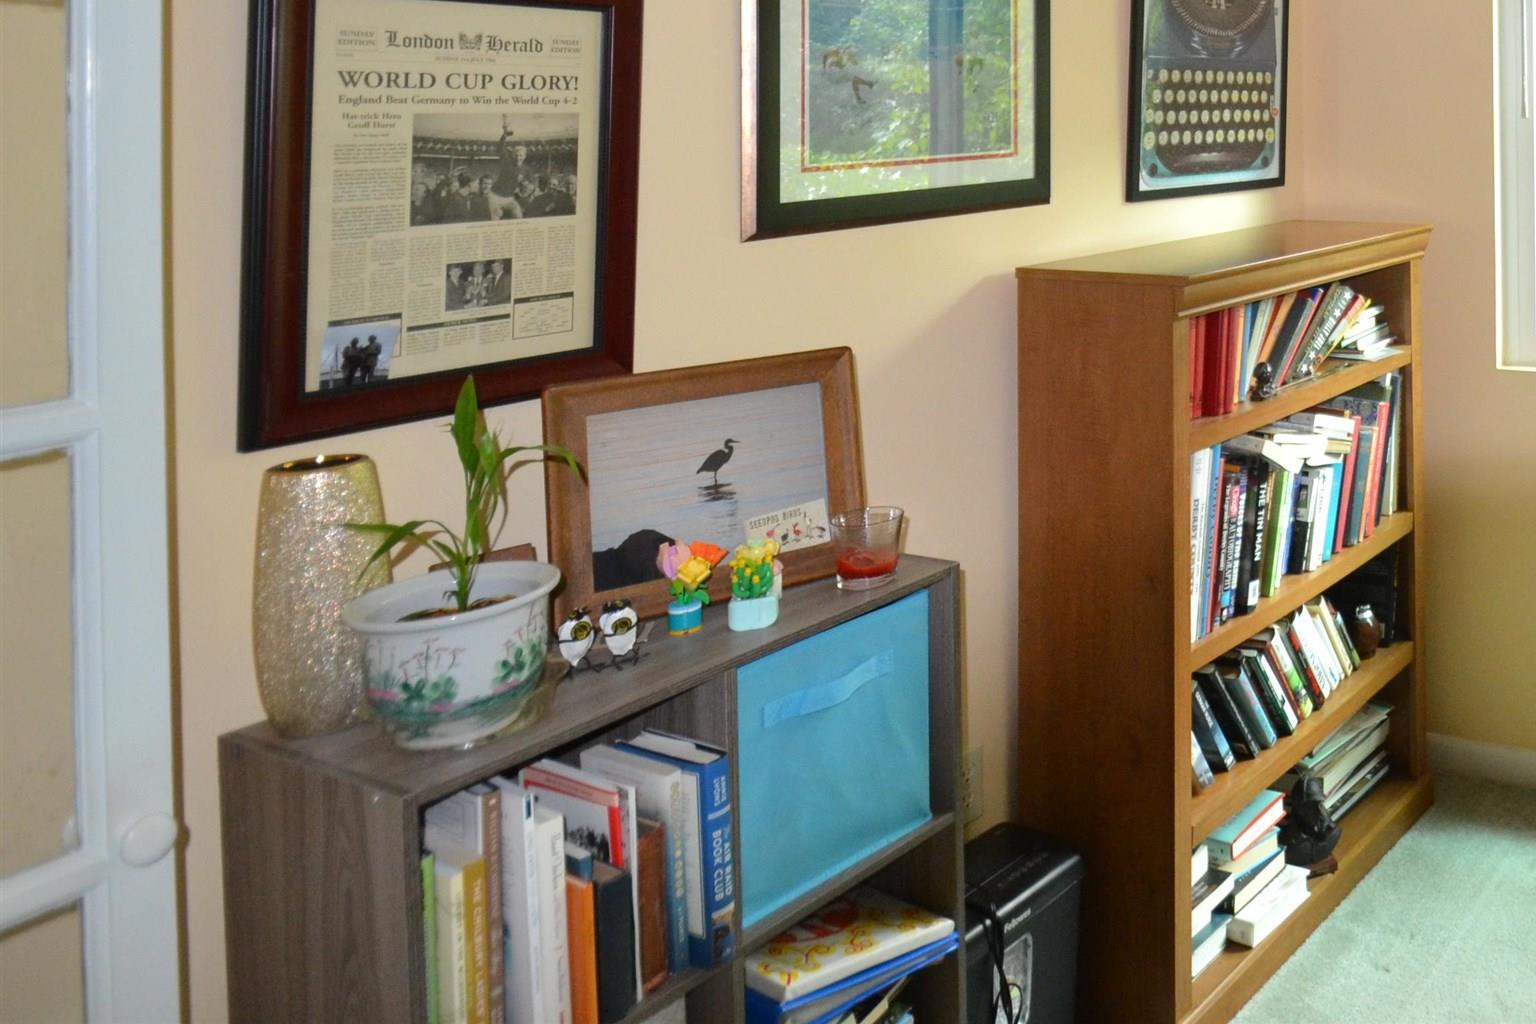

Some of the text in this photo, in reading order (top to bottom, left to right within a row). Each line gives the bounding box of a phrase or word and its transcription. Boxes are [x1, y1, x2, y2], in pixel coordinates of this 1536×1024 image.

[384, 30, 544, 54] London Herald
[337, 70, 579, 91] WORLD CUP GLORY!
[338, 94, 382, 107] England
[385, 95, 408, 105] Beat
[411, 95, 456, 108] Germany
[459, 96, 470, 105] to
[472, 96, 492, 105] Win
[495, 96, 510, 105] the
[511, 96, 539, 105] World
[542, 96, 560, 108] Cup
[1254, 481, 1268, 562] THE TIN MAN
[723, 841, 732, 864] AIR
[712, 829, 725, 902] BOOK CLUB
